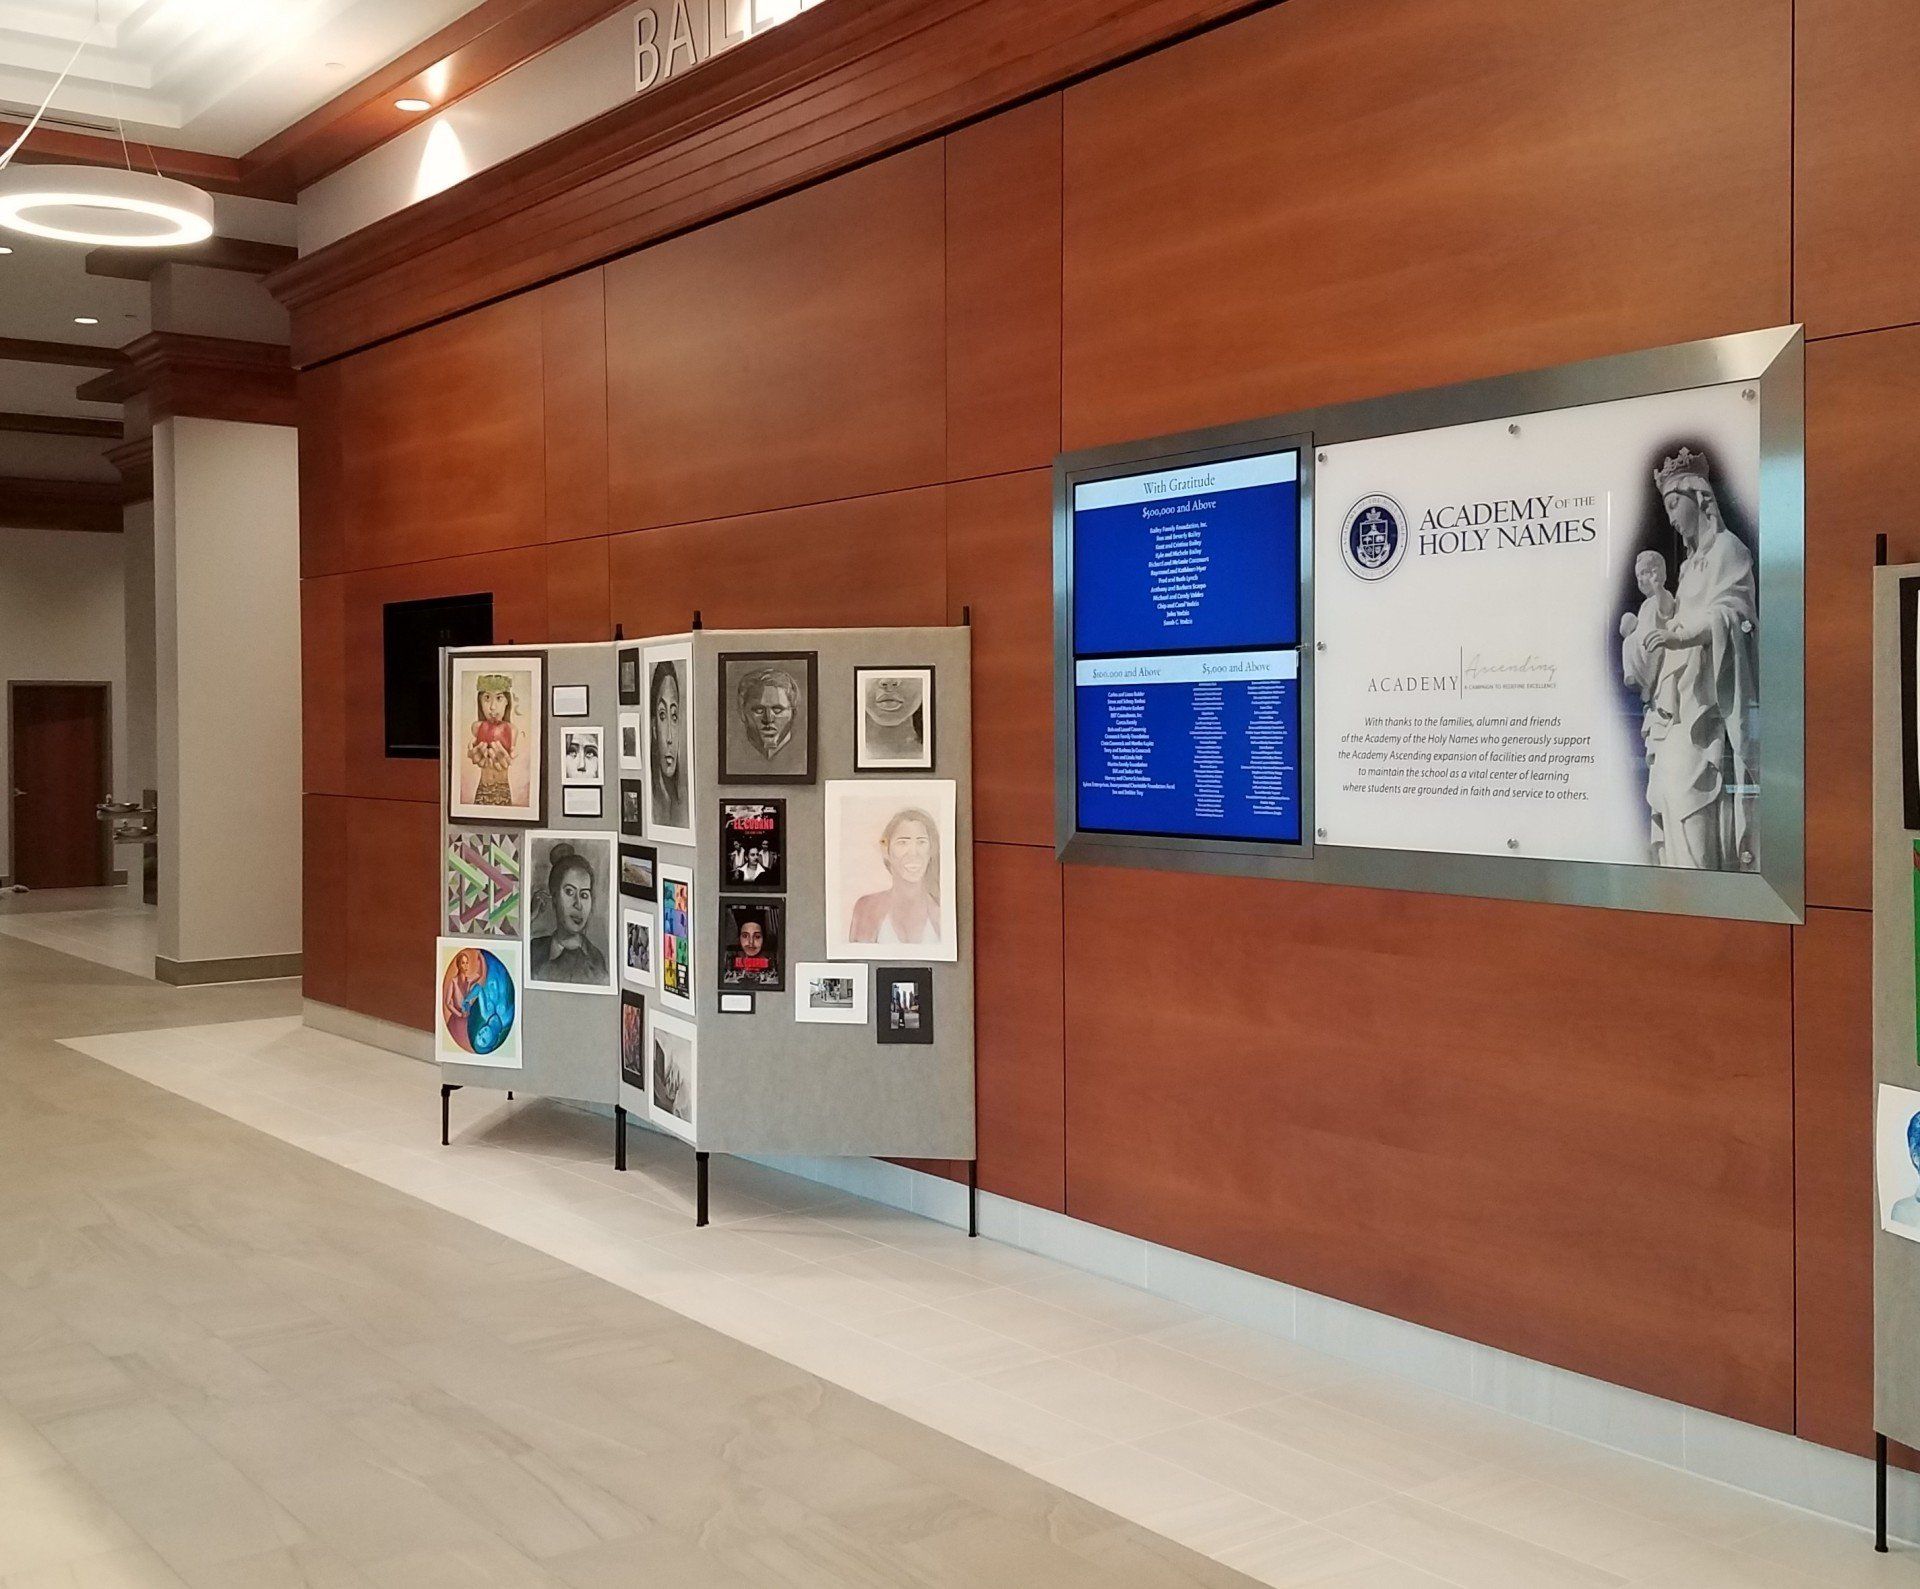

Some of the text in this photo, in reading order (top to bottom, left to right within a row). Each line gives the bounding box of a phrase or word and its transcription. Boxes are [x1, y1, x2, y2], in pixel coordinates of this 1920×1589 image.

[1143, 473, 1216, 495] With Gratitude
[1142, 499, 1217, 519] $500,000 and Above
[1419, 495, 1596, 531] ACADEMY OF THE
[1419, 517, 1597, 556] HOLY NAMES
[1124, 667, 1137, 678] and
[1138, 667, 1161, 677] Above
[1202, 660, 1271, 675] $5,000 and Above
[1367, 653, 1558, 693] ACADEMY Ascending
[1364, 716, 1561, 728] With thanks to the families, alumni and friends
[1341, 733, 1591, 747] of the Academy of the Holy Names who generously support
[1338, 750, 1595, 765] the Academy Ascending expansion of facilities and programs
[1358, 767, 1570, 783] to maintain the school as a vital center of learning
[1342, 782, 1589, 800] where students are grounded in faith and service to others.
